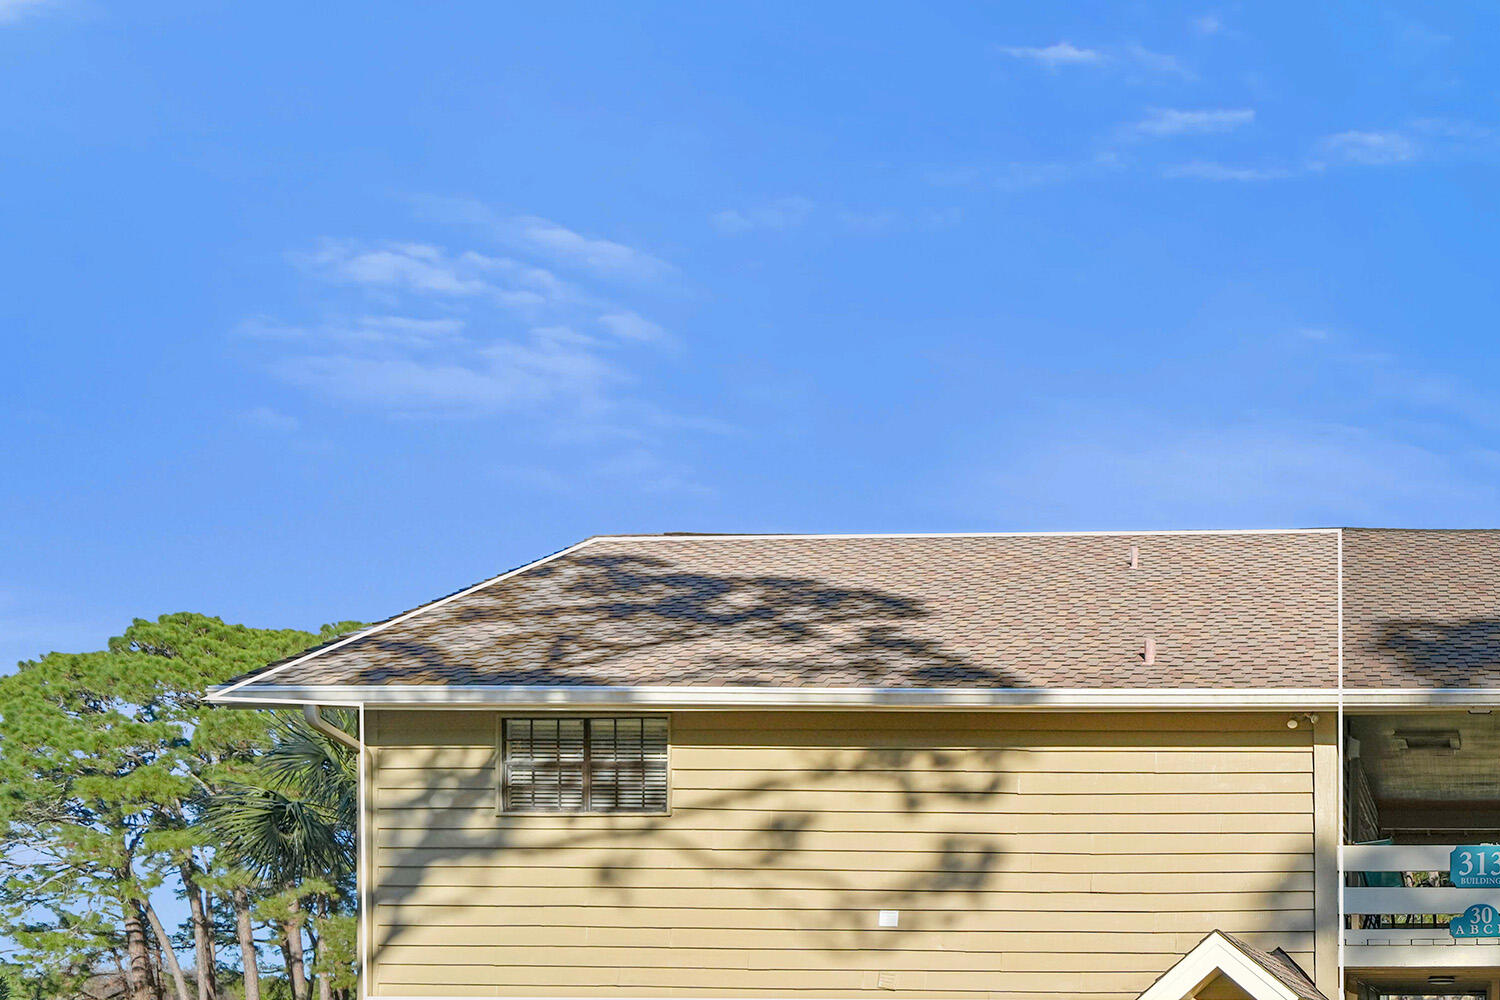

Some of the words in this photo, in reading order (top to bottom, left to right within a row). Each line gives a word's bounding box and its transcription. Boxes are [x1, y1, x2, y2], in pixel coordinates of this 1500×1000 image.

[1469, 907, 1493, 924] 30
[1455, 925, 1465, 935] A
[1470, 924, 1479, 935] B
[1483, 923, 1493, 935] C
